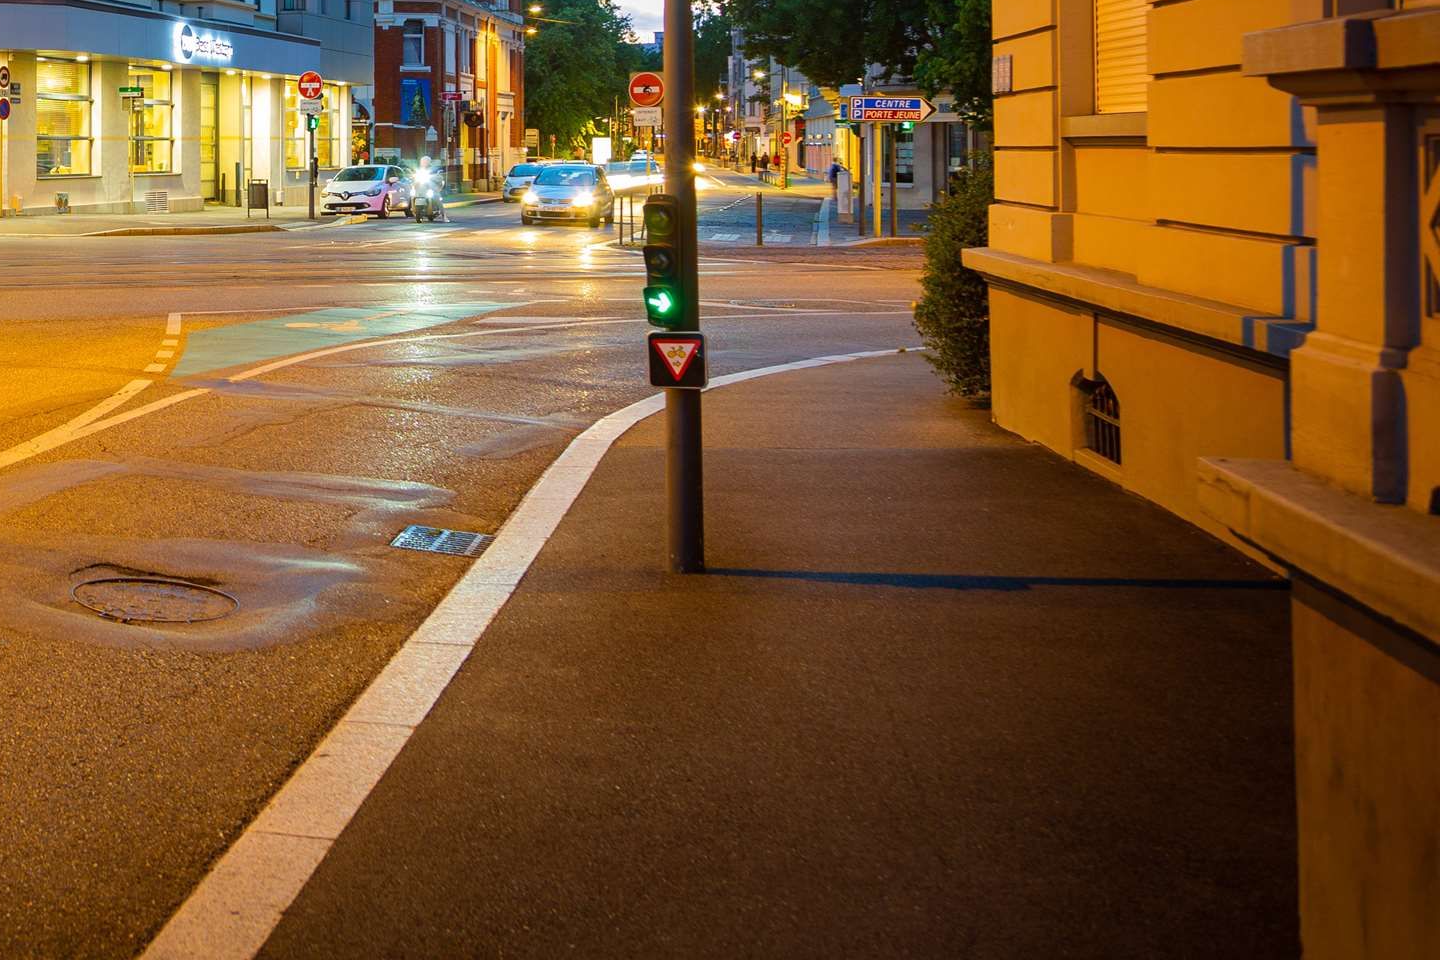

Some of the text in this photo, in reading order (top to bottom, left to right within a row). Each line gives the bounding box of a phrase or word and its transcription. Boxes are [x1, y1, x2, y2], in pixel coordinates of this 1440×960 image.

[854, 100, 911, 108] P CENTRE
[854, 111, 921, 120] P PORTE JEUNE
